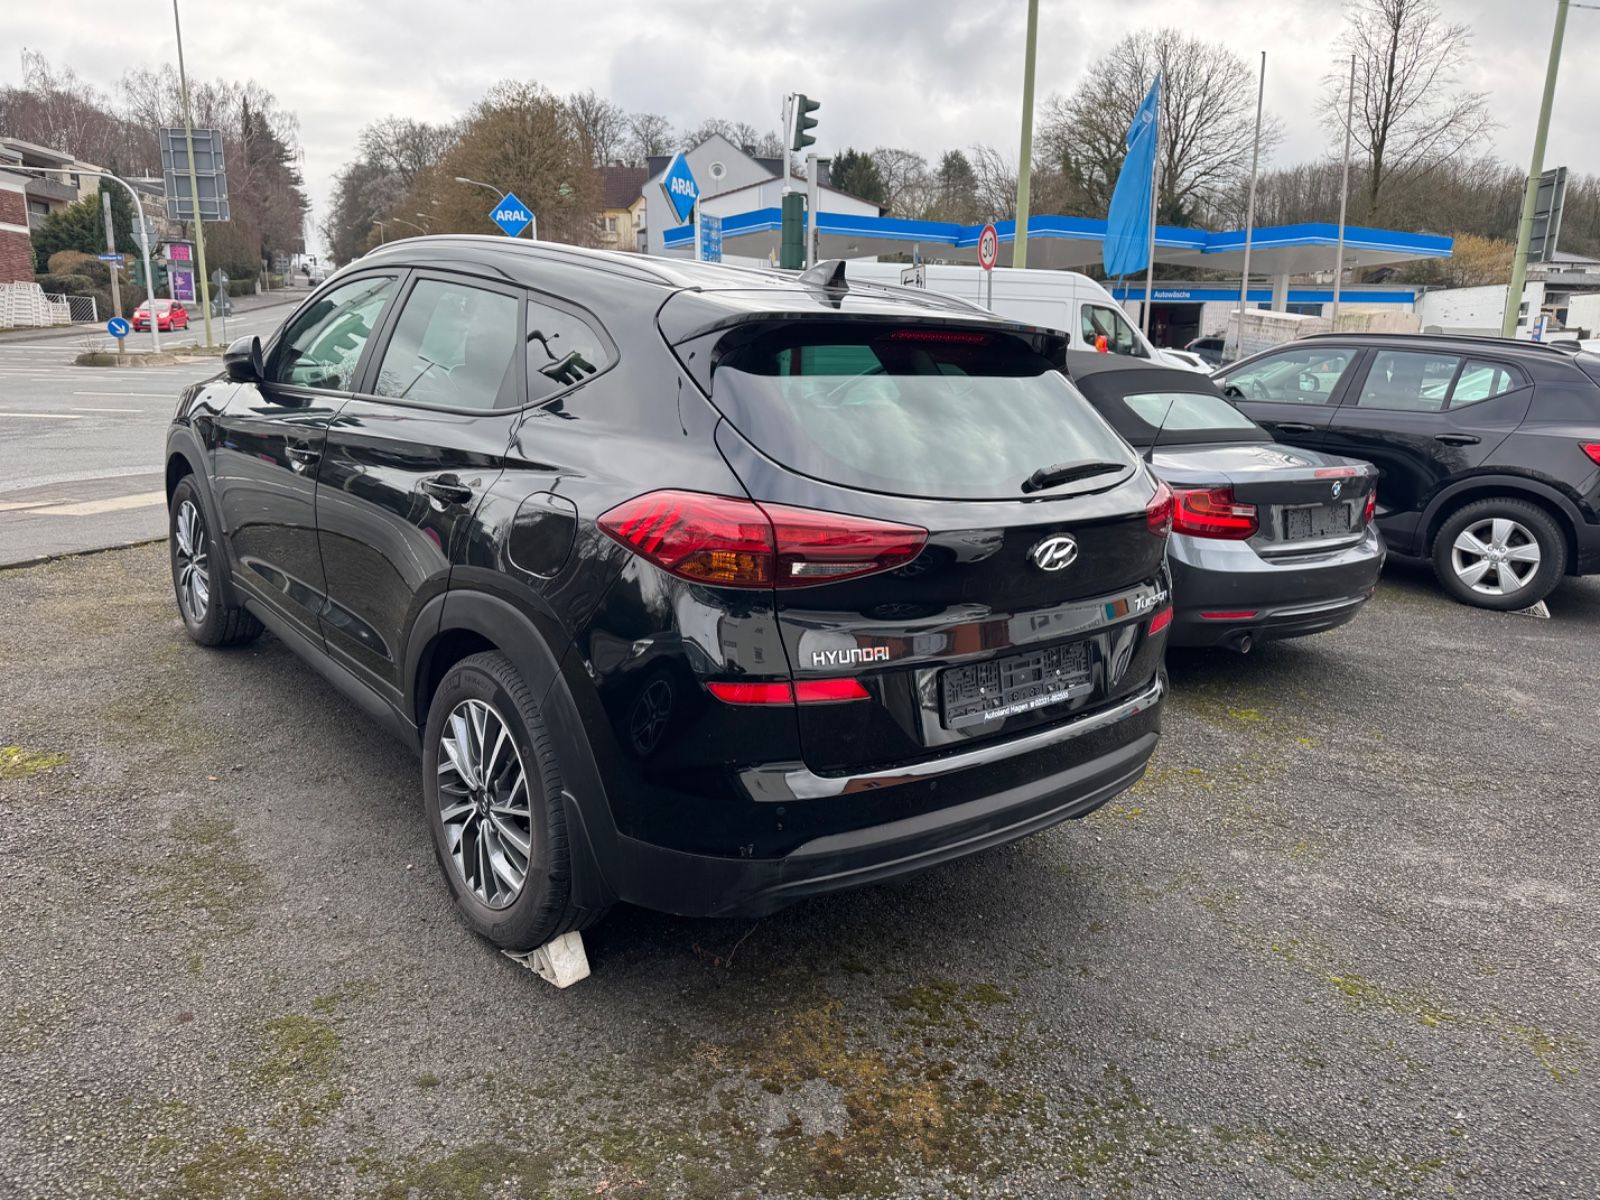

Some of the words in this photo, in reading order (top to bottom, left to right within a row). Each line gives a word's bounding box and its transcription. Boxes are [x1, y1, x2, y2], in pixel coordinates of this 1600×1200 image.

[671, 176, 697, 199] ARAL
[496, 210, 528, 221] ARAL
[983, 237, 994, 258] 30
[1153, 290, 1191, 298] Autowäsche
[812, 646, 890, 666] HYUNDAI
[1010, 703, 1028, 713] Hagen
